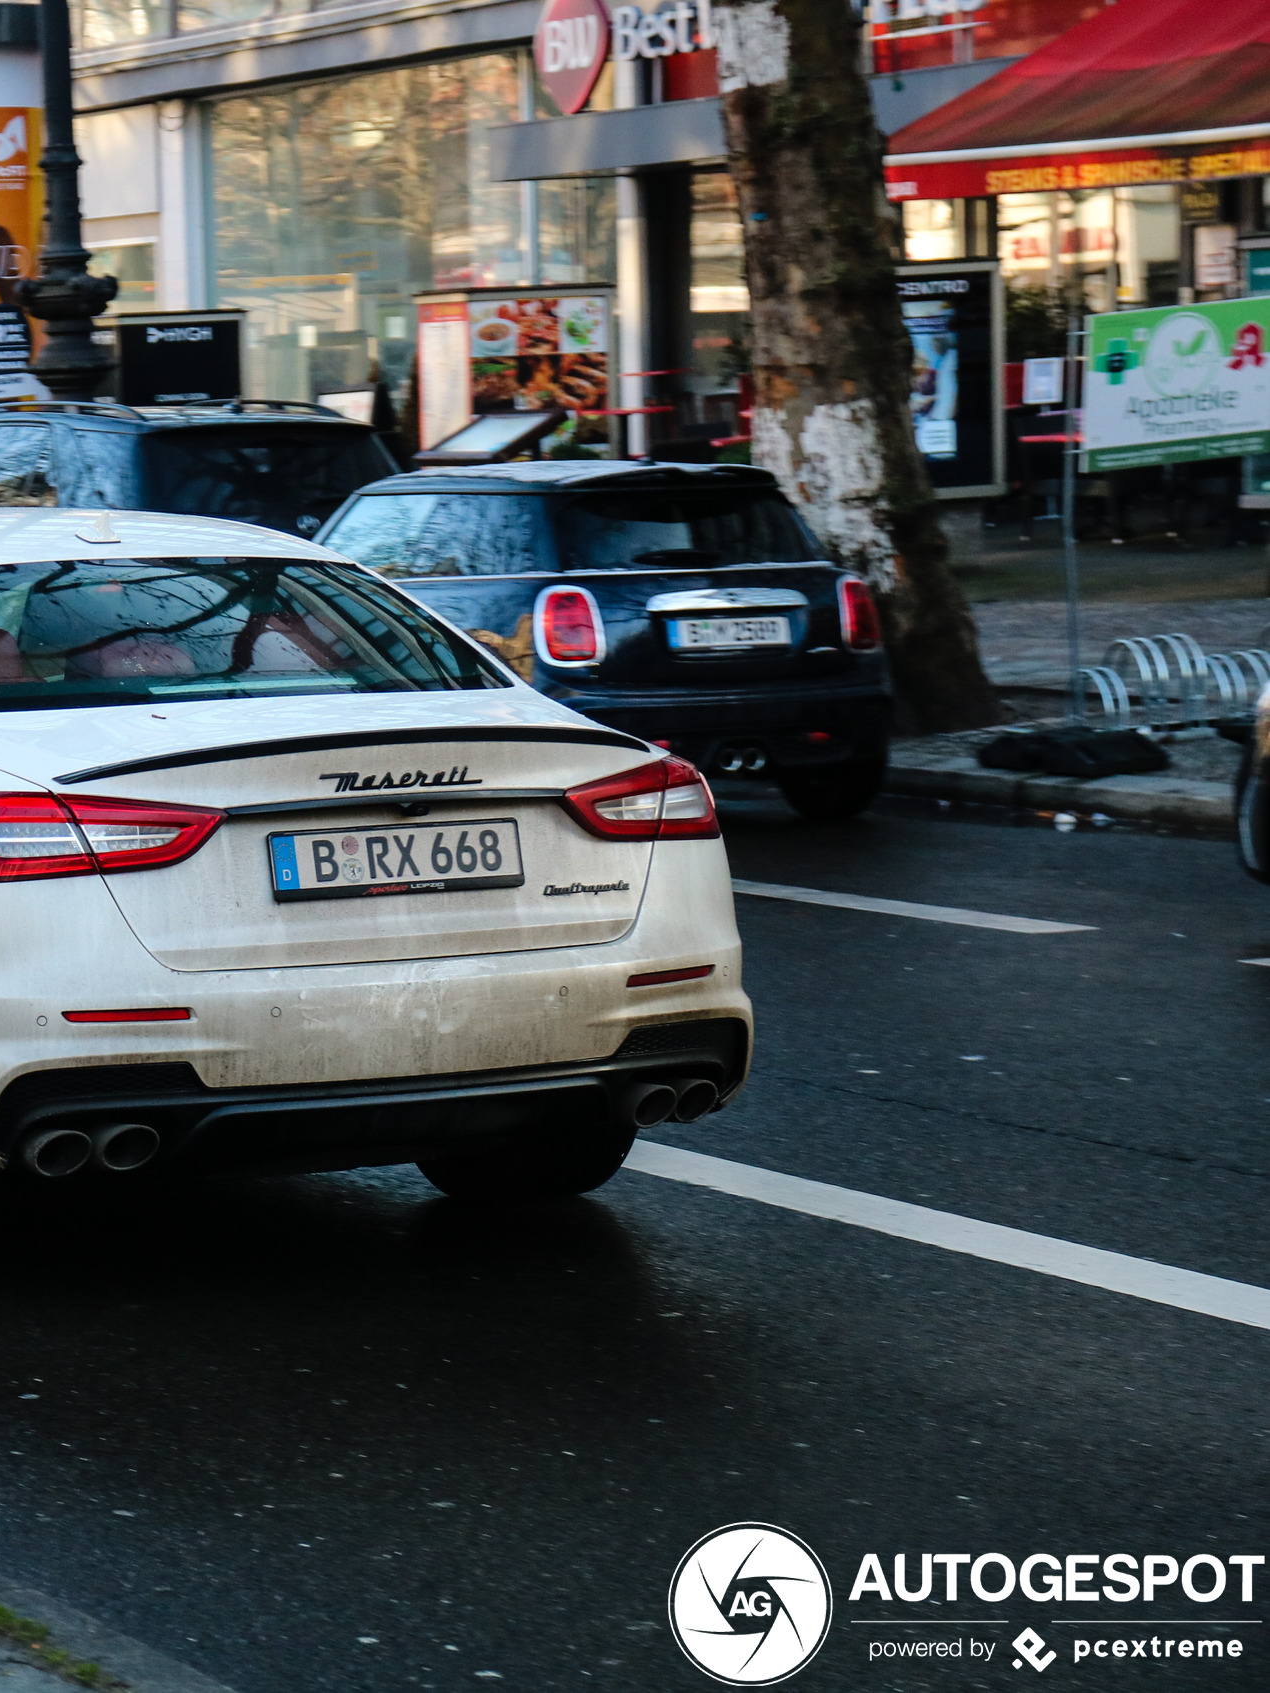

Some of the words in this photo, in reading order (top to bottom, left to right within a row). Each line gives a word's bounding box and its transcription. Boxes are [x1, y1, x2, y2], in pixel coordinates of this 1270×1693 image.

[613, 2, 694, 61] Best
[1124, 385, 1240, 418] Apotheke
[320, 765, 483, 793] Maserati
[312, 839, 339, 882] B
[366, 834, 420, 879] RX
[431, 829, 503, 874] 668
[283, 869, 292, 881] D
[543, 880, 630, 896] Quattroporte
